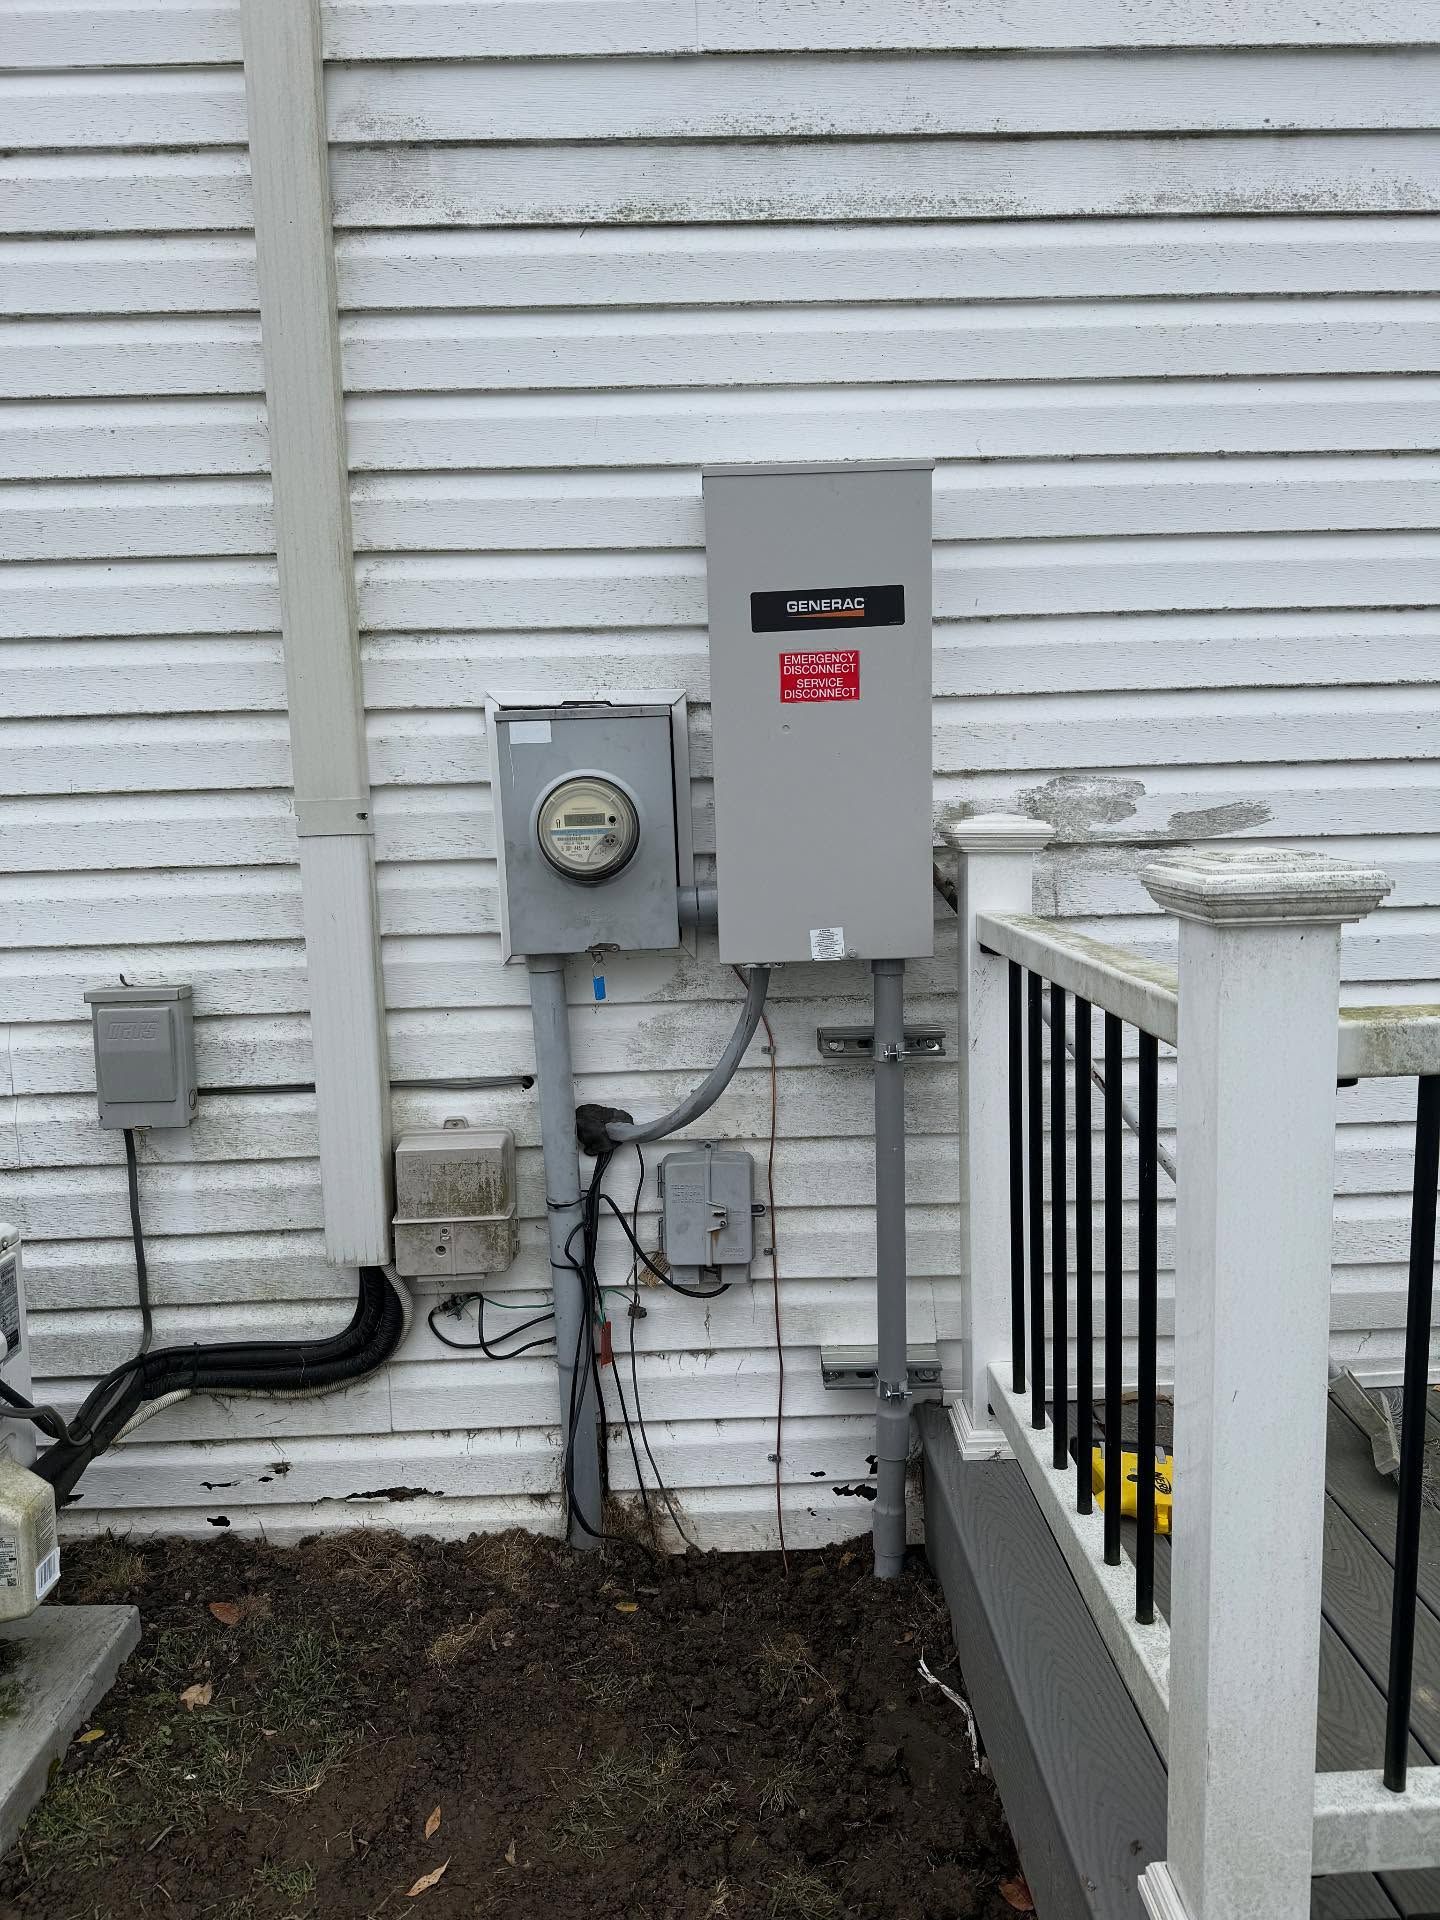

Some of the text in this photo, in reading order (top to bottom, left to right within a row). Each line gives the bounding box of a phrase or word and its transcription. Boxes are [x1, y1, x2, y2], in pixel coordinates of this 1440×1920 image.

[786, 597, 865, 613] GENERAC
[784, 652, 855, 665] EMERGENCY
[783, 663, 857, 675] DISCONNECT
[796, 677, 844, 689] SERVICE
[784, 687, 857, 699] DISCONNECT
